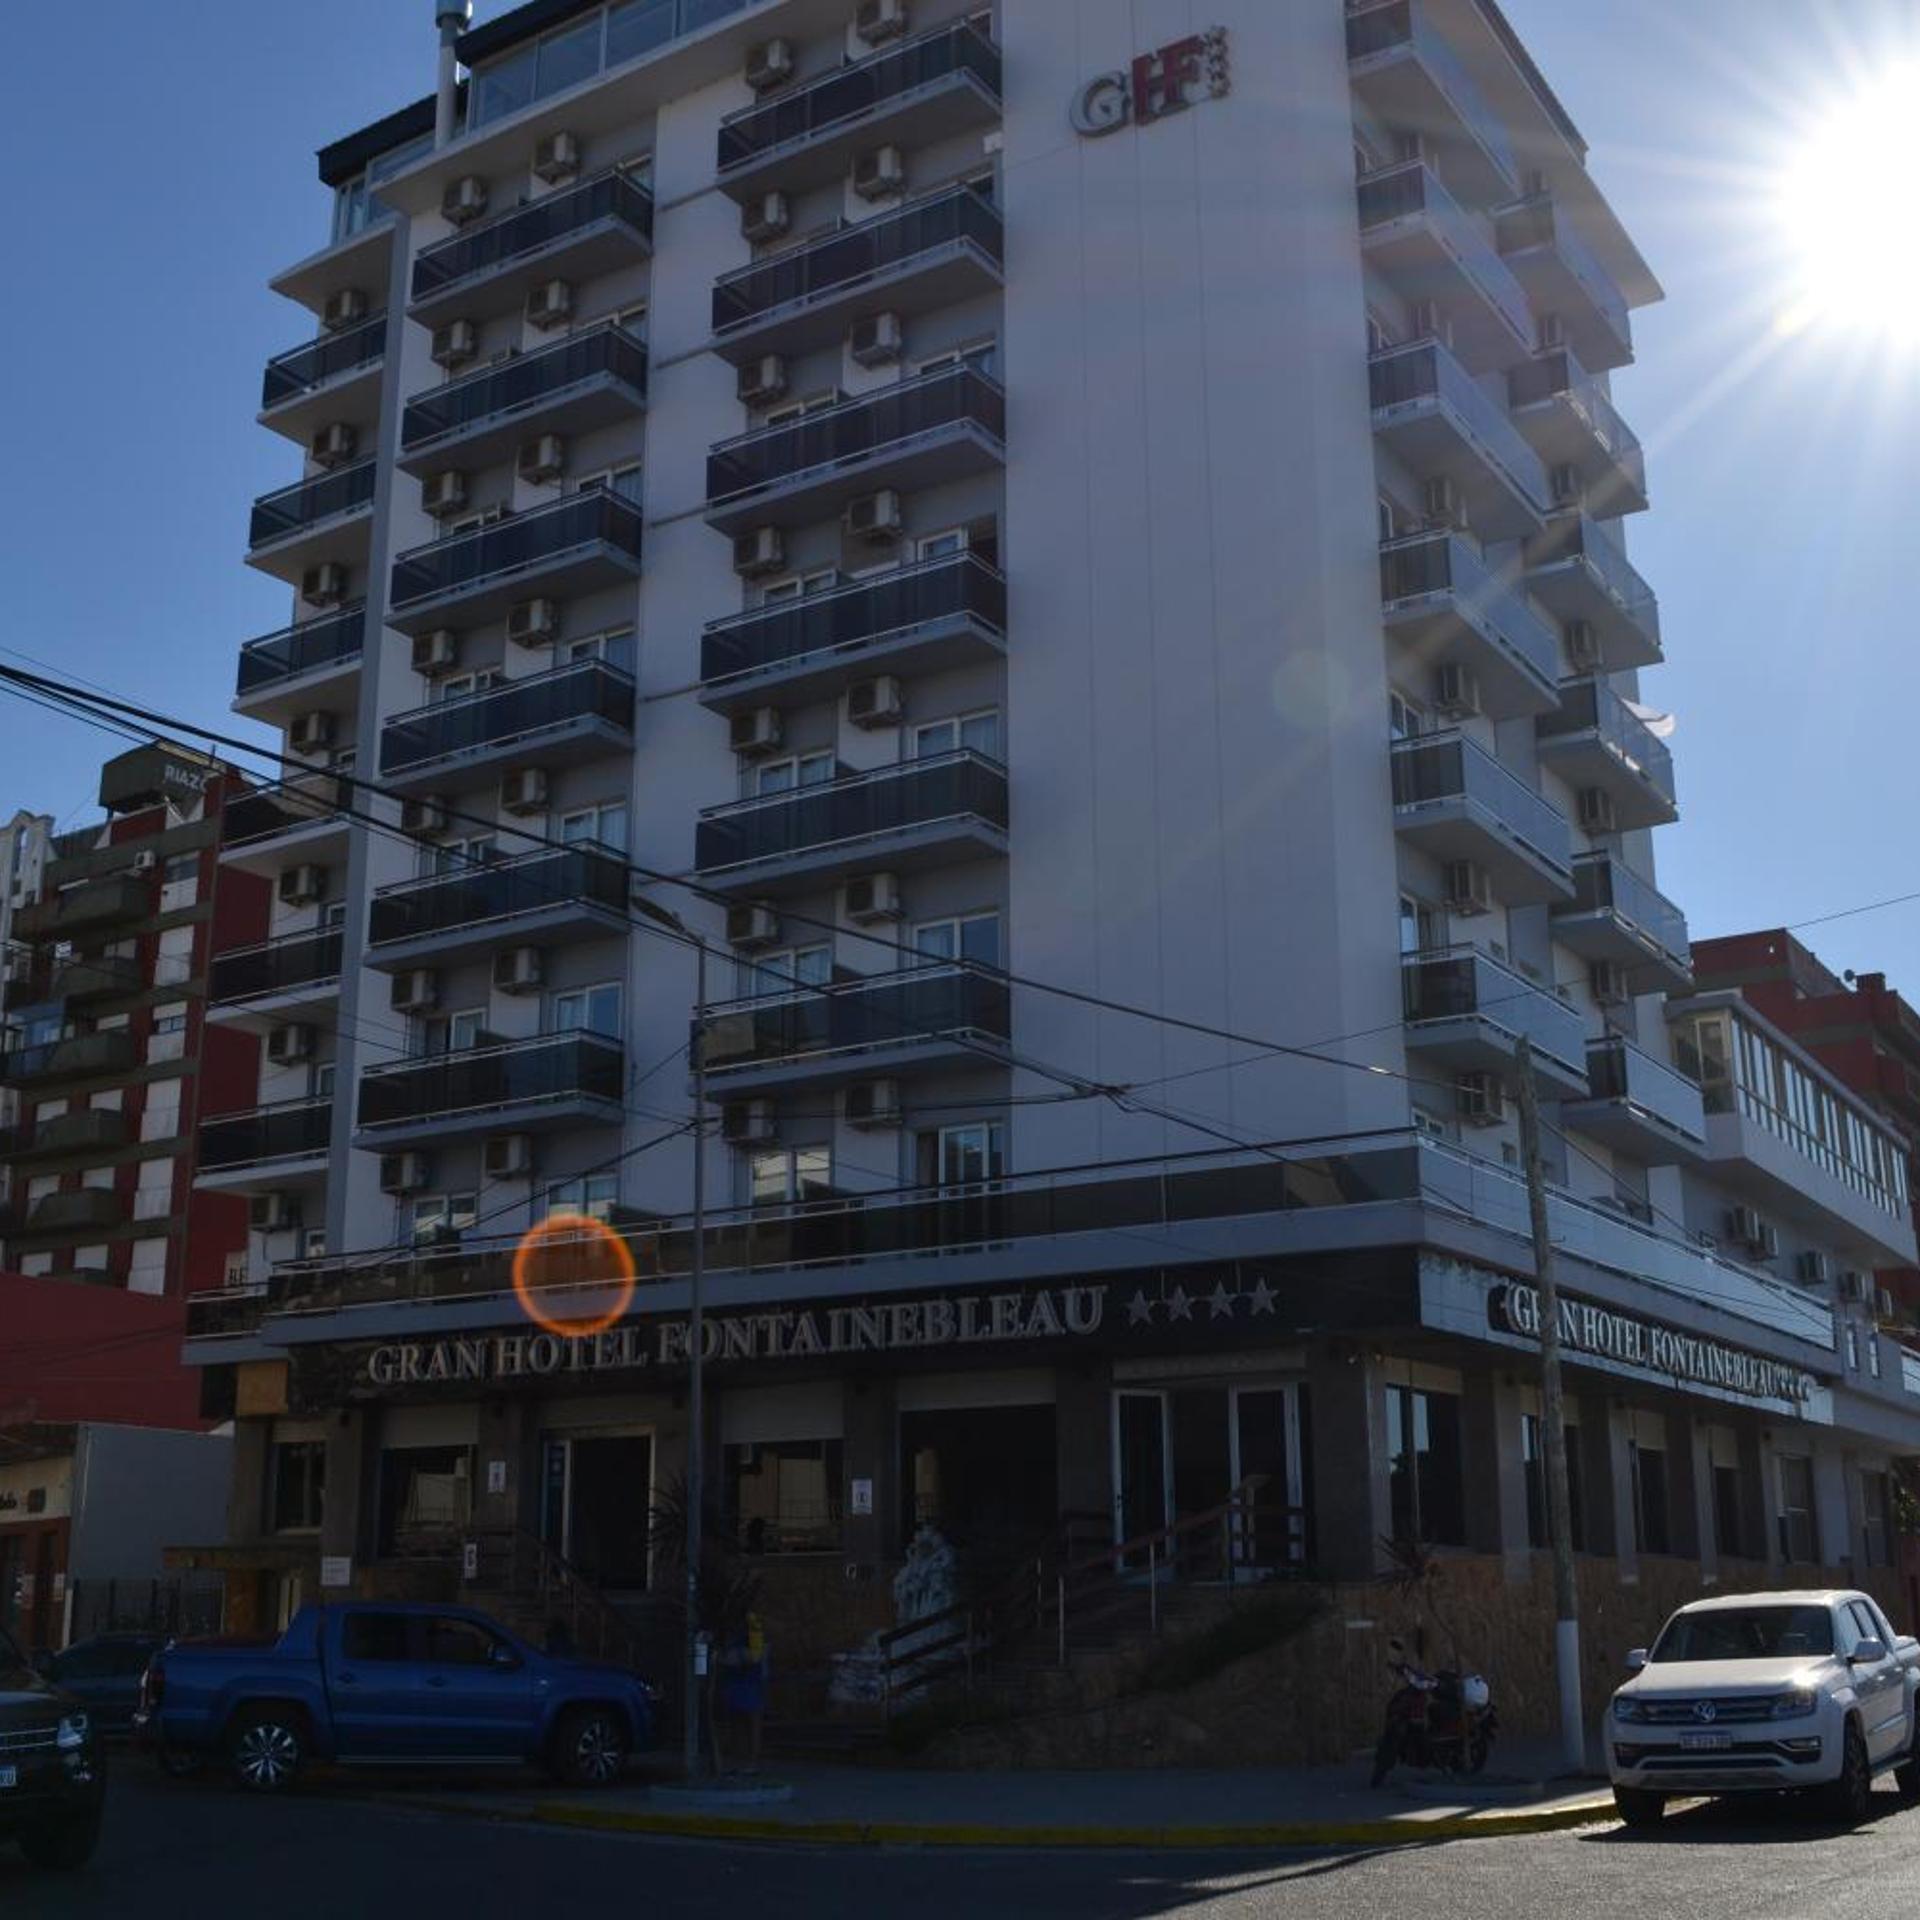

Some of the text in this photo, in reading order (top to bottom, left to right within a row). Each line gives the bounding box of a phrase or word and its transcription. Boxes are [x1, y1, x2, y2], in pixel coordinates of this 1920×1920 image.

[368, 1284, 1108, 1384] GRAN HOTEL FONTAINEBLEAU
[1583, 1307, 1645, 1362] HOTEL
[1651, 1327, 1778, 1396] FONTAINEBLEAU
